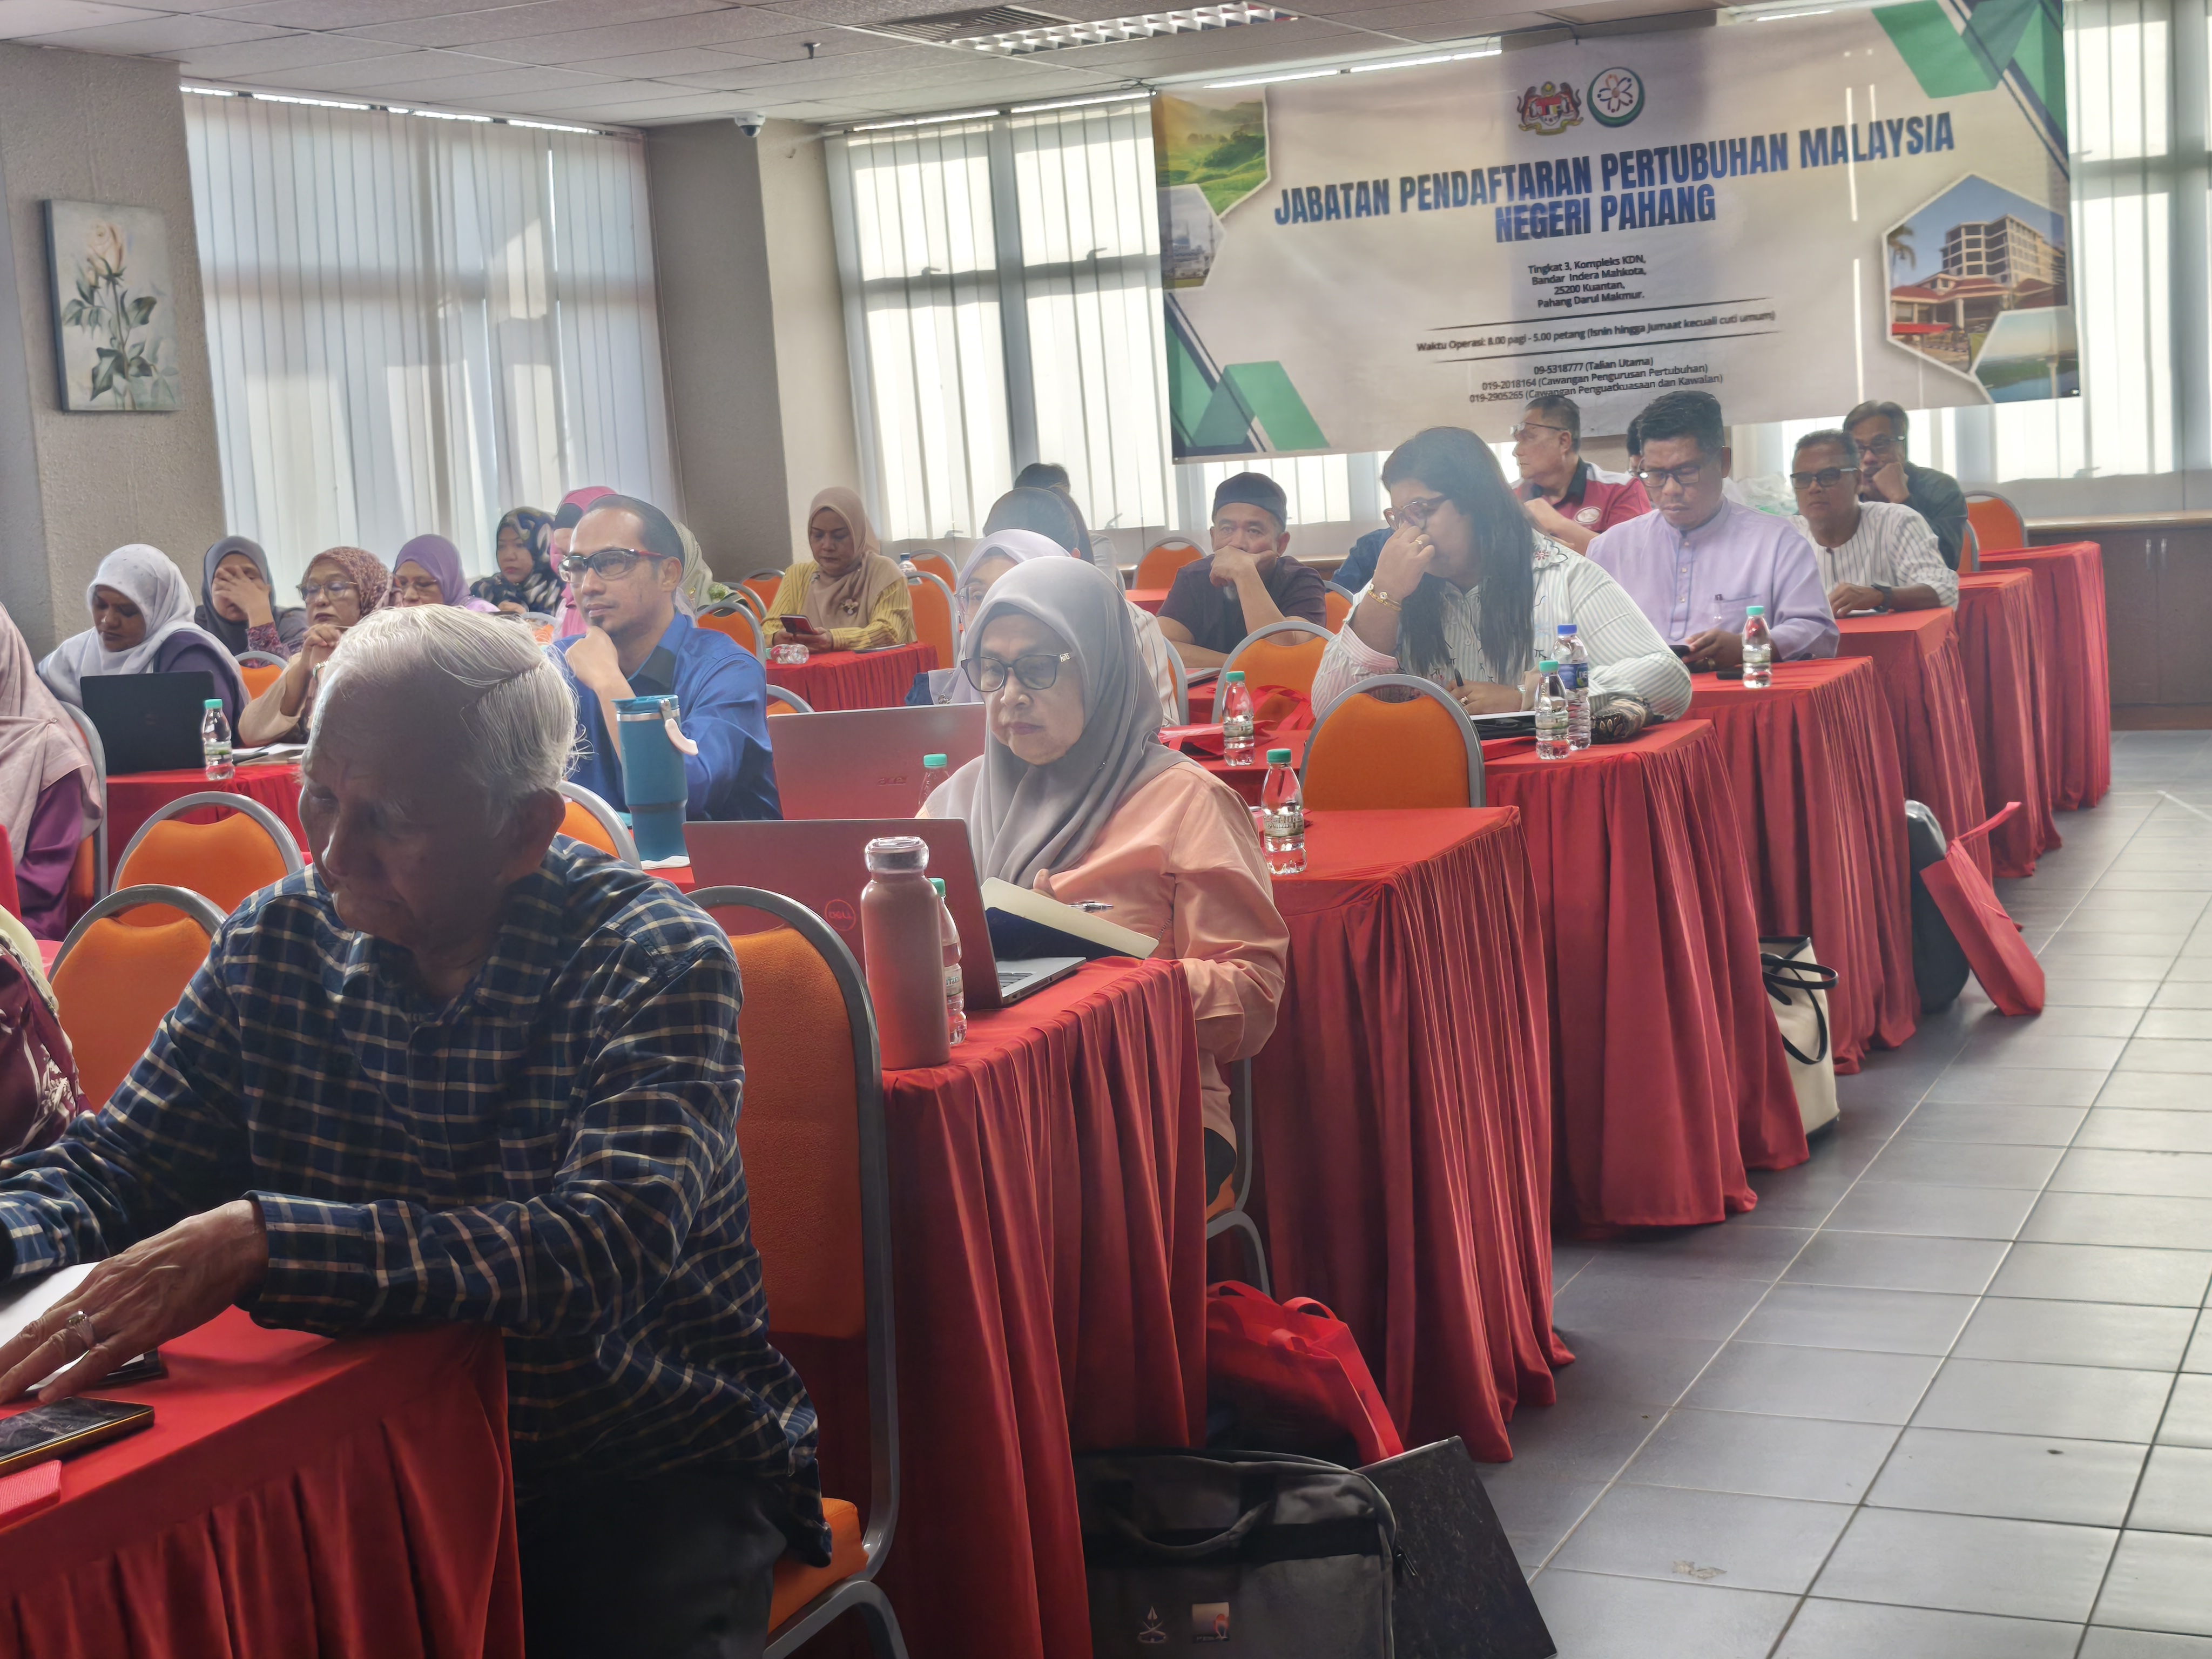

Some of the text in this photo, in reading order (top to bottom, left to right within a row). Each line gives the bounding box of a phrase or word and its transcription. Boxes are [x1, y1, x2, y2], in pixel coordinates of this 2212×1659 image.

[1274, 111, 1954, 225] JABATAN PENDAFTARAN PERTUBUHAN MALAYSIA
[1495, 184, 1716, 242] NEGERI PAHANG
[1528, 255, 1647, 275] Tingkat 3, Kompleks KDN,
[1532, 267, 1647, 285] Bandar Indera Mahkota,
[1554, 282, 1625, 295] 25200 Kuantan,
[1537, 292, 1645, 308] Pahang Darul Makmur.
[1417, 342, 1447, 352] Waktu
[1449, 338, 1486, 349] Operasi:
[1488, 336, 1506, 345] 8.00
[1507, 334, 1527, 347] pagi
[1533, 333, 1552, 341] 5.00
[1553, 330, 1586, 342] petang
[1588, 326, 1612, 339] (Isnin
[1615, 325, 1645, 336] hingga
[1683, 316, 1717, 328] kecuali
[1719, 314, 1738, 324] cuti
[1739, 311, 1776, 322] umum)
[1534, 357, 1654, 375] 09-5318777 (Talian Utama)
[1482, 363, 1708, 390] 019-2018164 (Cawangan Pengurusan Pertubuhan)
[1526, 387, 1576, 400] (Cawangan
[1579, 381, 1656, 395] Penguatkuasaan
[1658, 379, 1676, 387] dan
[1678, 374, 1723, 386] Kawalan)
[878, 775, 908, 785] acer
